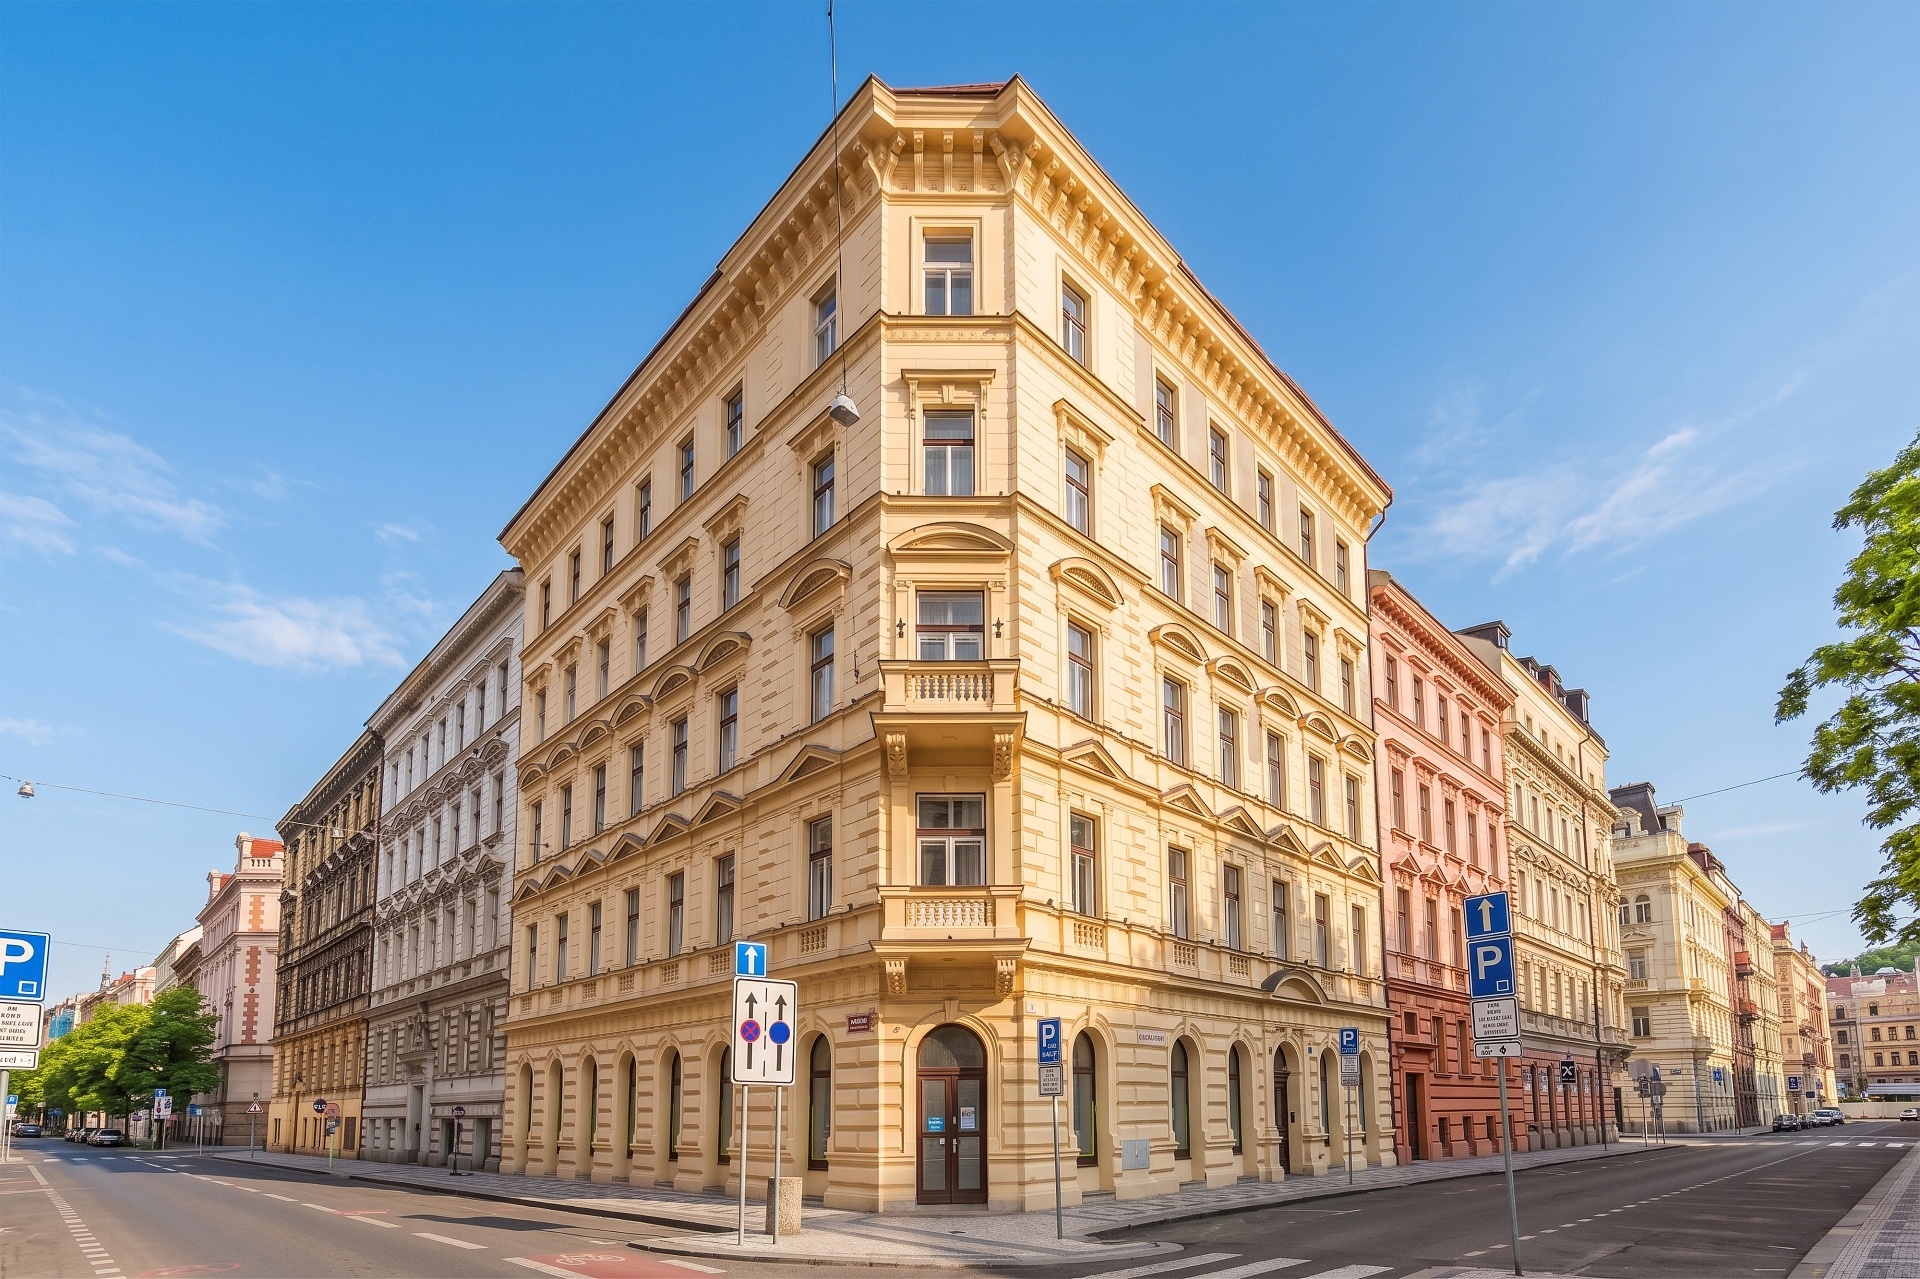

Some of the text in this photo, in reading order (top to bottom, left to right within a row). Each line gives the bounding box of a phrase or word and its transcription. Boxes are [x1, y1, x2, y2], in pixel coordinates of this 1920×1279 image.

[0, 937, 34, 976] P
[1476, 945, 1503, 980] P
[1042, 1024, 1056, 1048] P
[1342, 1030, 1355, 1046] P
